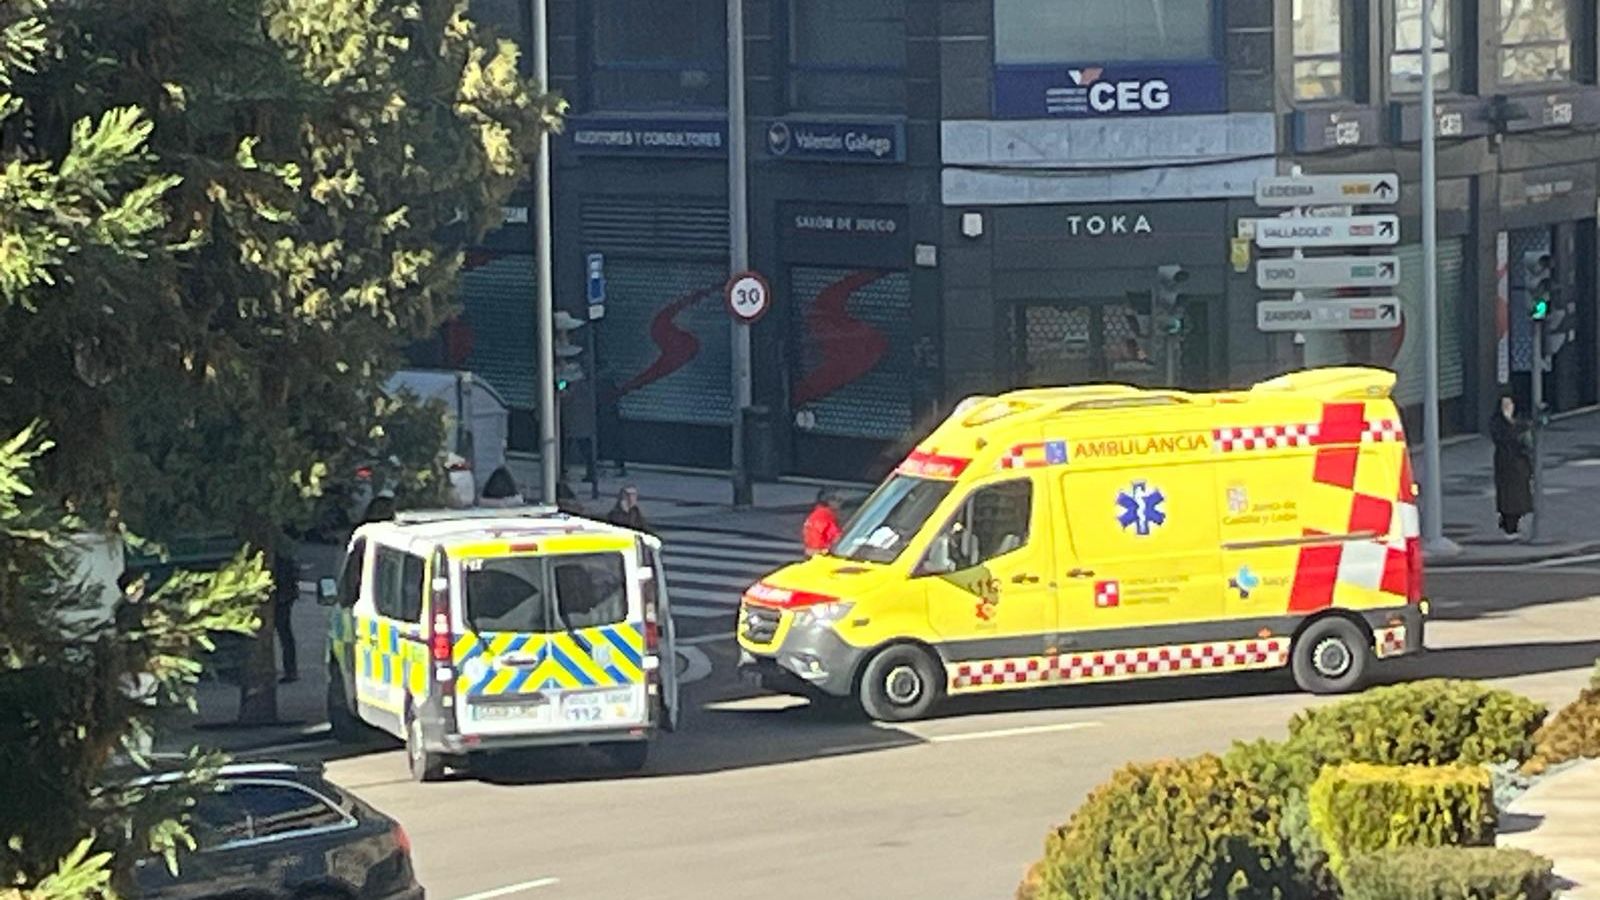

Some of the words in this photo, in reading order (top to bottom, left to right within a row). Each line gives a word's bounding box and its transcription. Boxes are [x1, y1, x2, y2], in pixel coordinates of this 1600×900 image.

[1089, 80, 1171, 112] CEG
[643, 132, 721, 147] CONSULTORES
[845, 132, 891, 156] Gallego
[836, 217, 851, 230] DE
[856, 218, 896, 232] JUEGO
[1067, 215, 1152, 235] TOKA
[736, 288, 760, 305] 30
[1074, 434, 1208, 459] AMBULANCIA
[571, 706, 602, 720] 112
